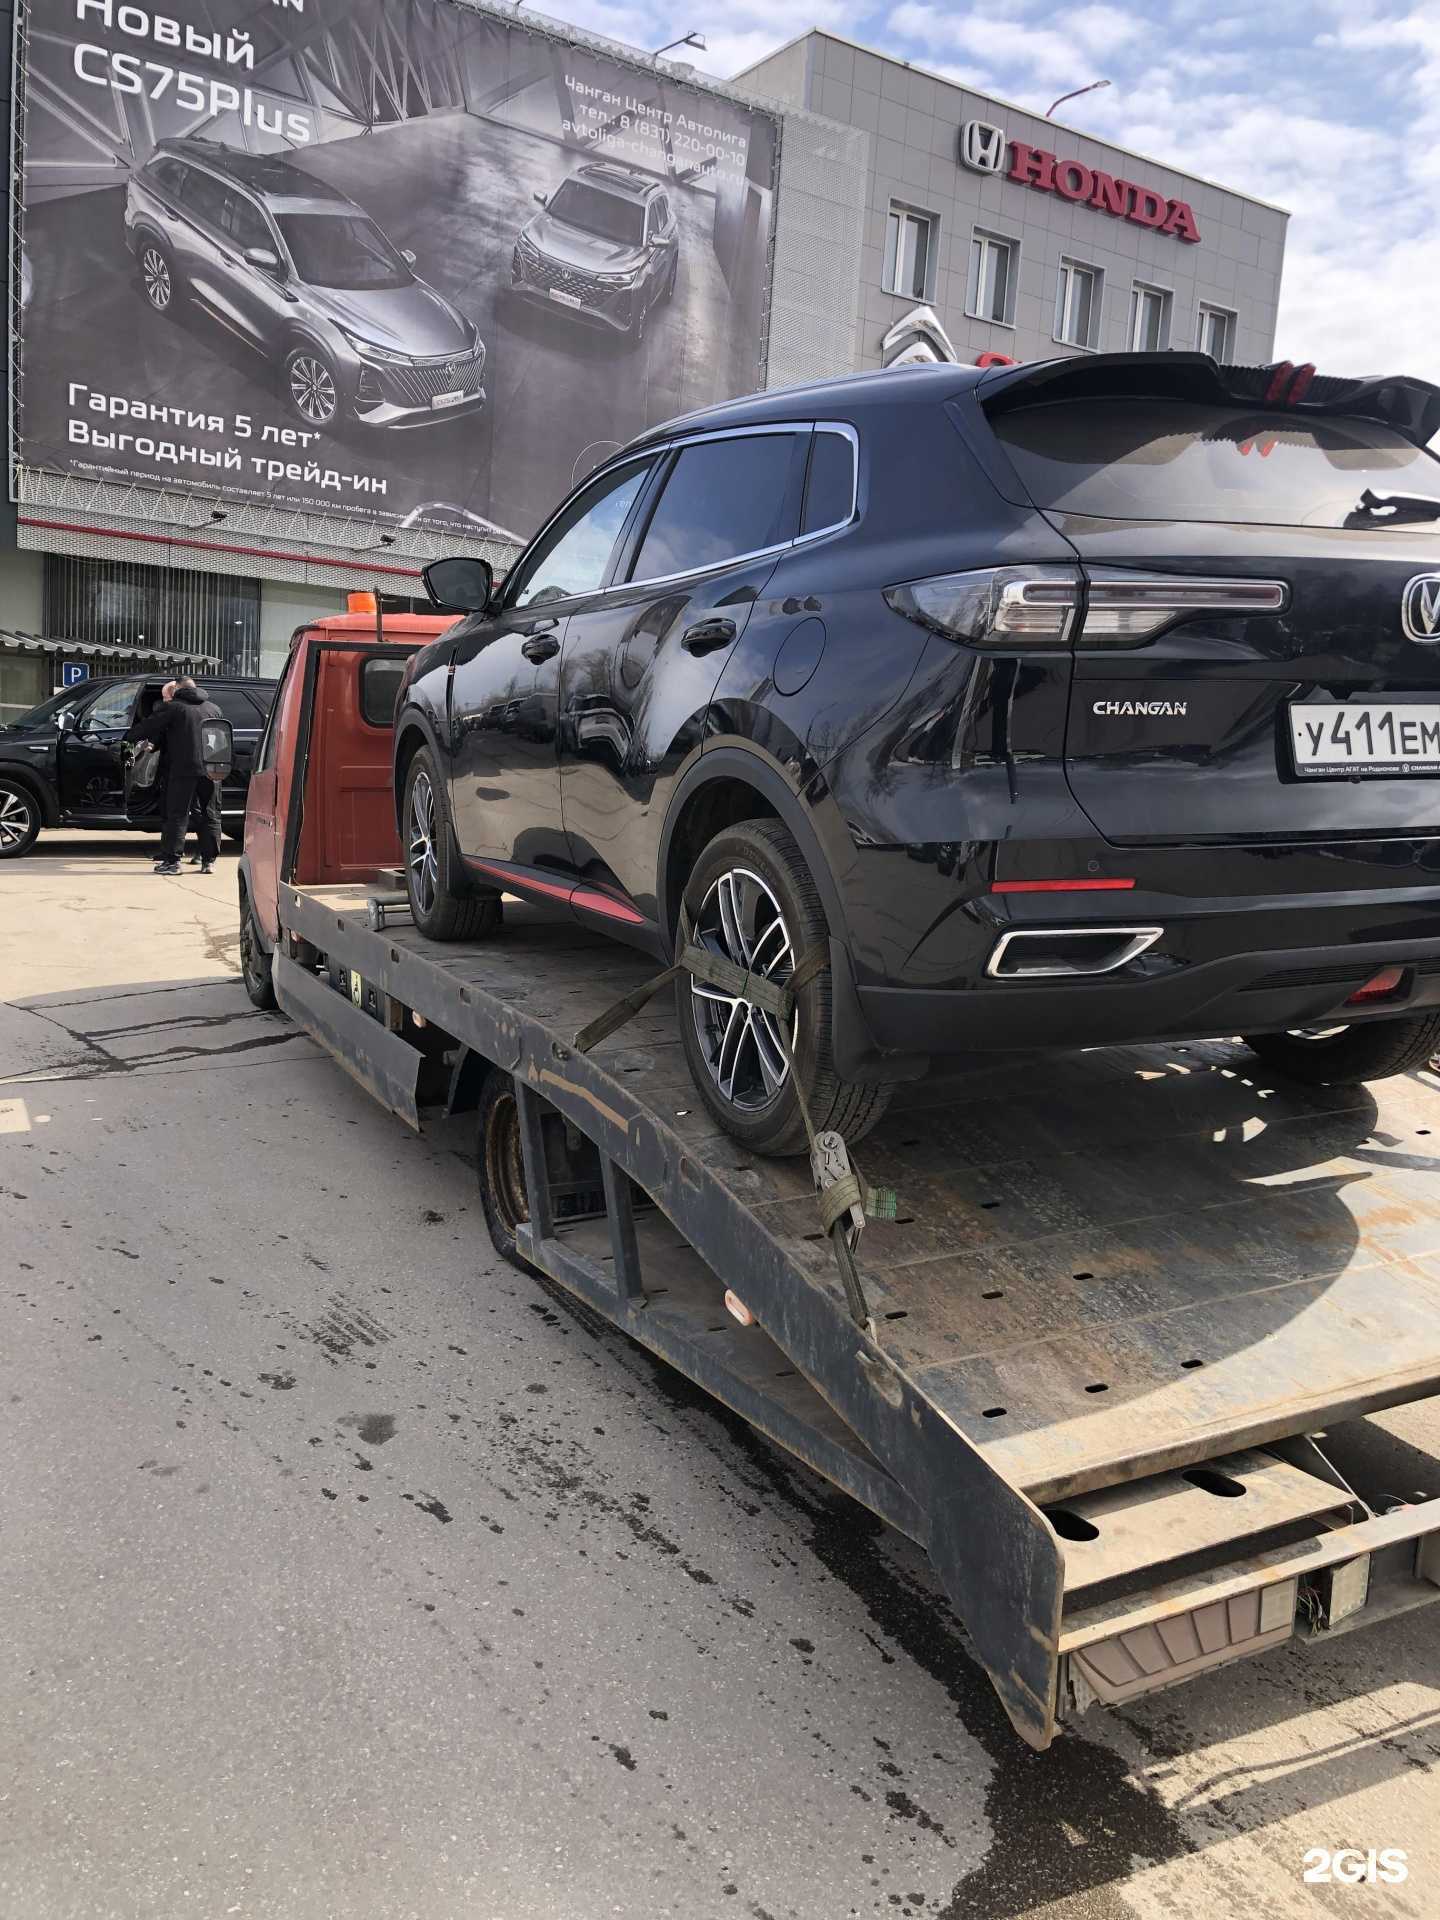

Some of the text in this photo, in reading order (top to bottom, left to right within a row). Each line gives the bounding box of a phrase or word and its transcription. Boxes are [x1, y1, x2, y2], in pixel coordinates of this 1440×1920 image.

[74, 43, 310, 142] CS75Plus
[564, 74, 747, 148] Чанган Центр Автолига
[579, 104, 746, 167] тел.: 8 (831) 220-00-10
[1006, 141, 1202, 243] HONDA
[68, 382, 225, 433] Гарантия
[234, 414, 252, 438] 5
[68, 419, 387, 495] Выгодный трейд-ин
[130, 470, 161, 482] период
[173, 477, 221, 490] автомобиль
[222, 485, 265, 497] составляет
[272, 493, 286, 501] лет
[71, 667, 82, 683] P
[1092, 701, 1187, 715] CHANGAN
